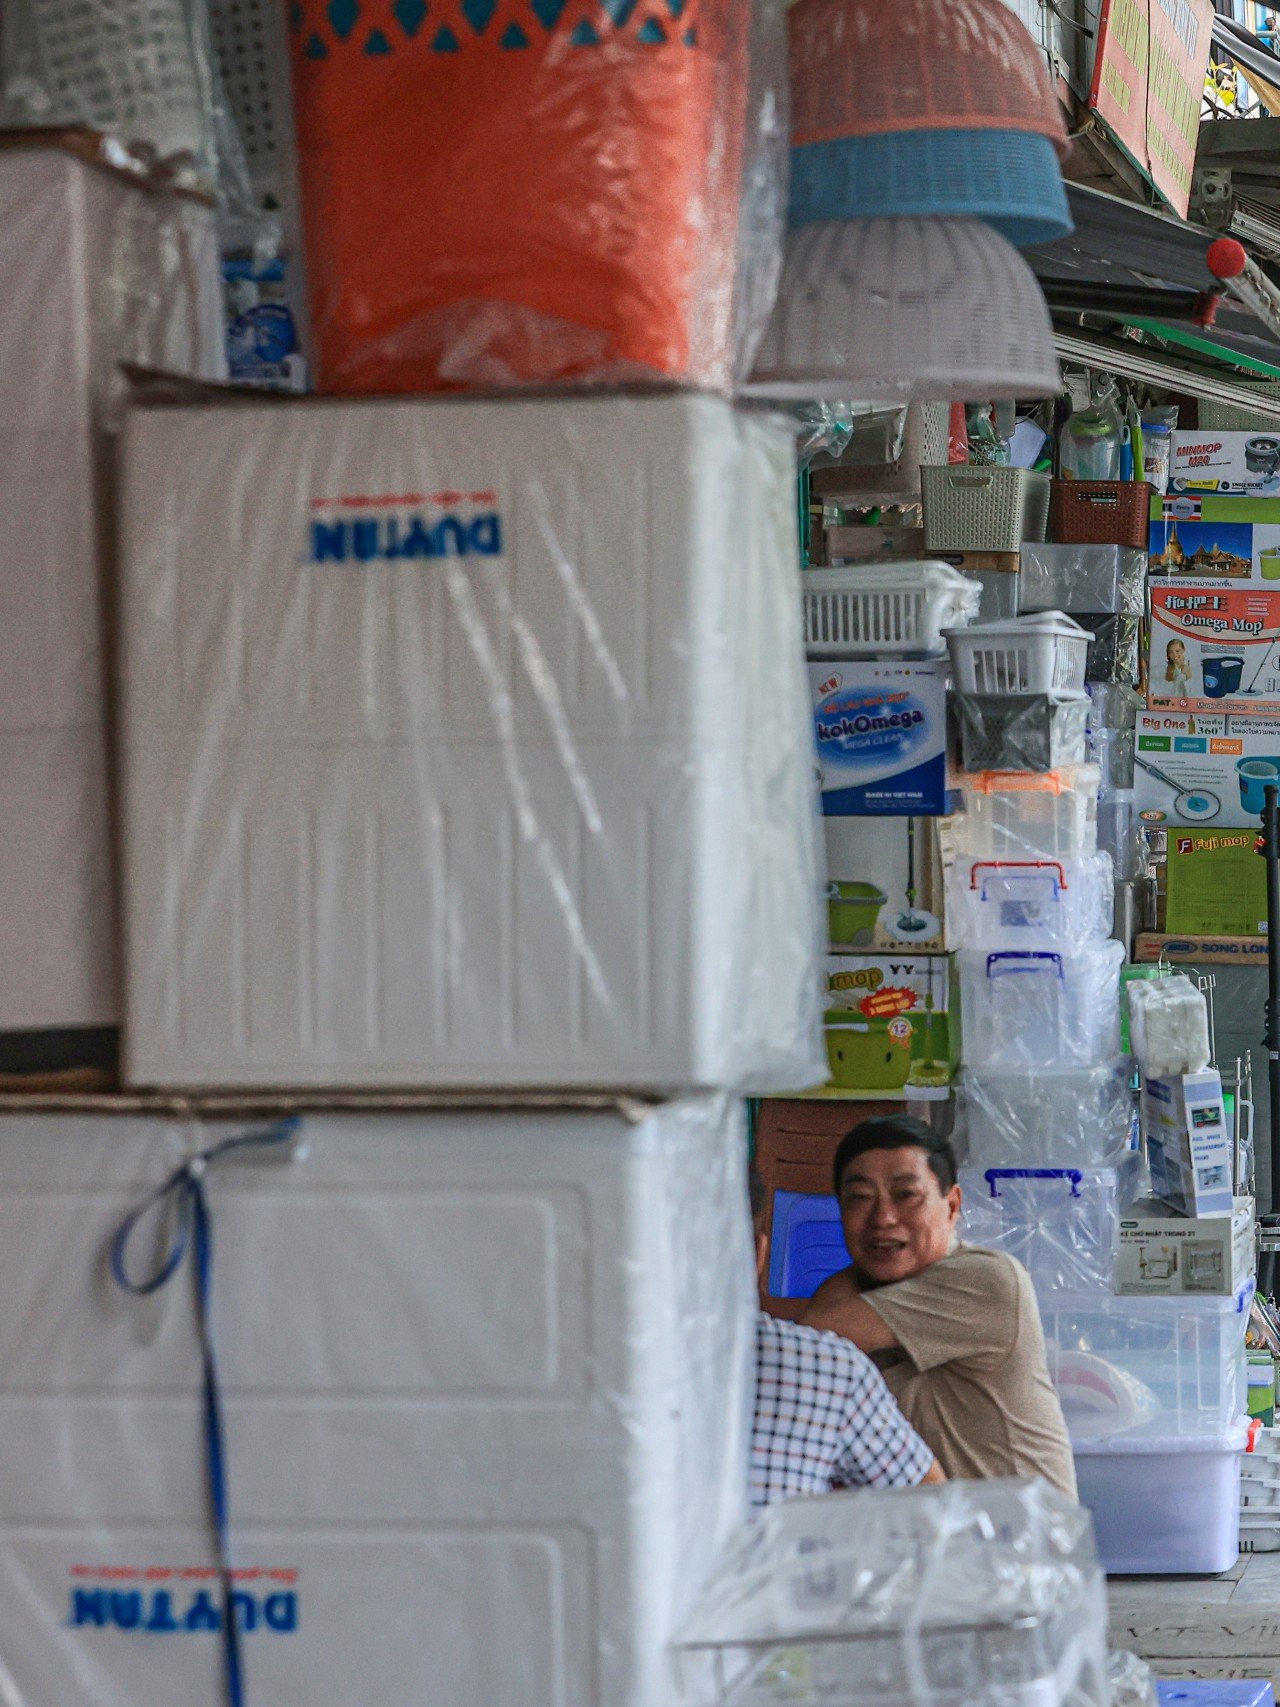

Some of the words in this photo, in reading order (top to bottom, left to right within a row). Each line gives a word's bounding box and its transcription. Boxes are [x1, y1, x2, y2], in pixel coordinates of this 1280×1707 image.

[1176, 442, 1222, 458] MINMOP
[1181, 613, 1228, 632] Omega
[1231, 618, 1264, 636] Mop
[1142, 717, 1161, 731] Big
[1163, 718, 1186, 730] One
[1195, 837, 1219, 852] Fuji
[1220, 835, 1249, 848] mop
[1201, 944, 1239, 954] SONG
[1242, 944, 1270, 954] LON
[894, 1024, 907, 1034] 12
